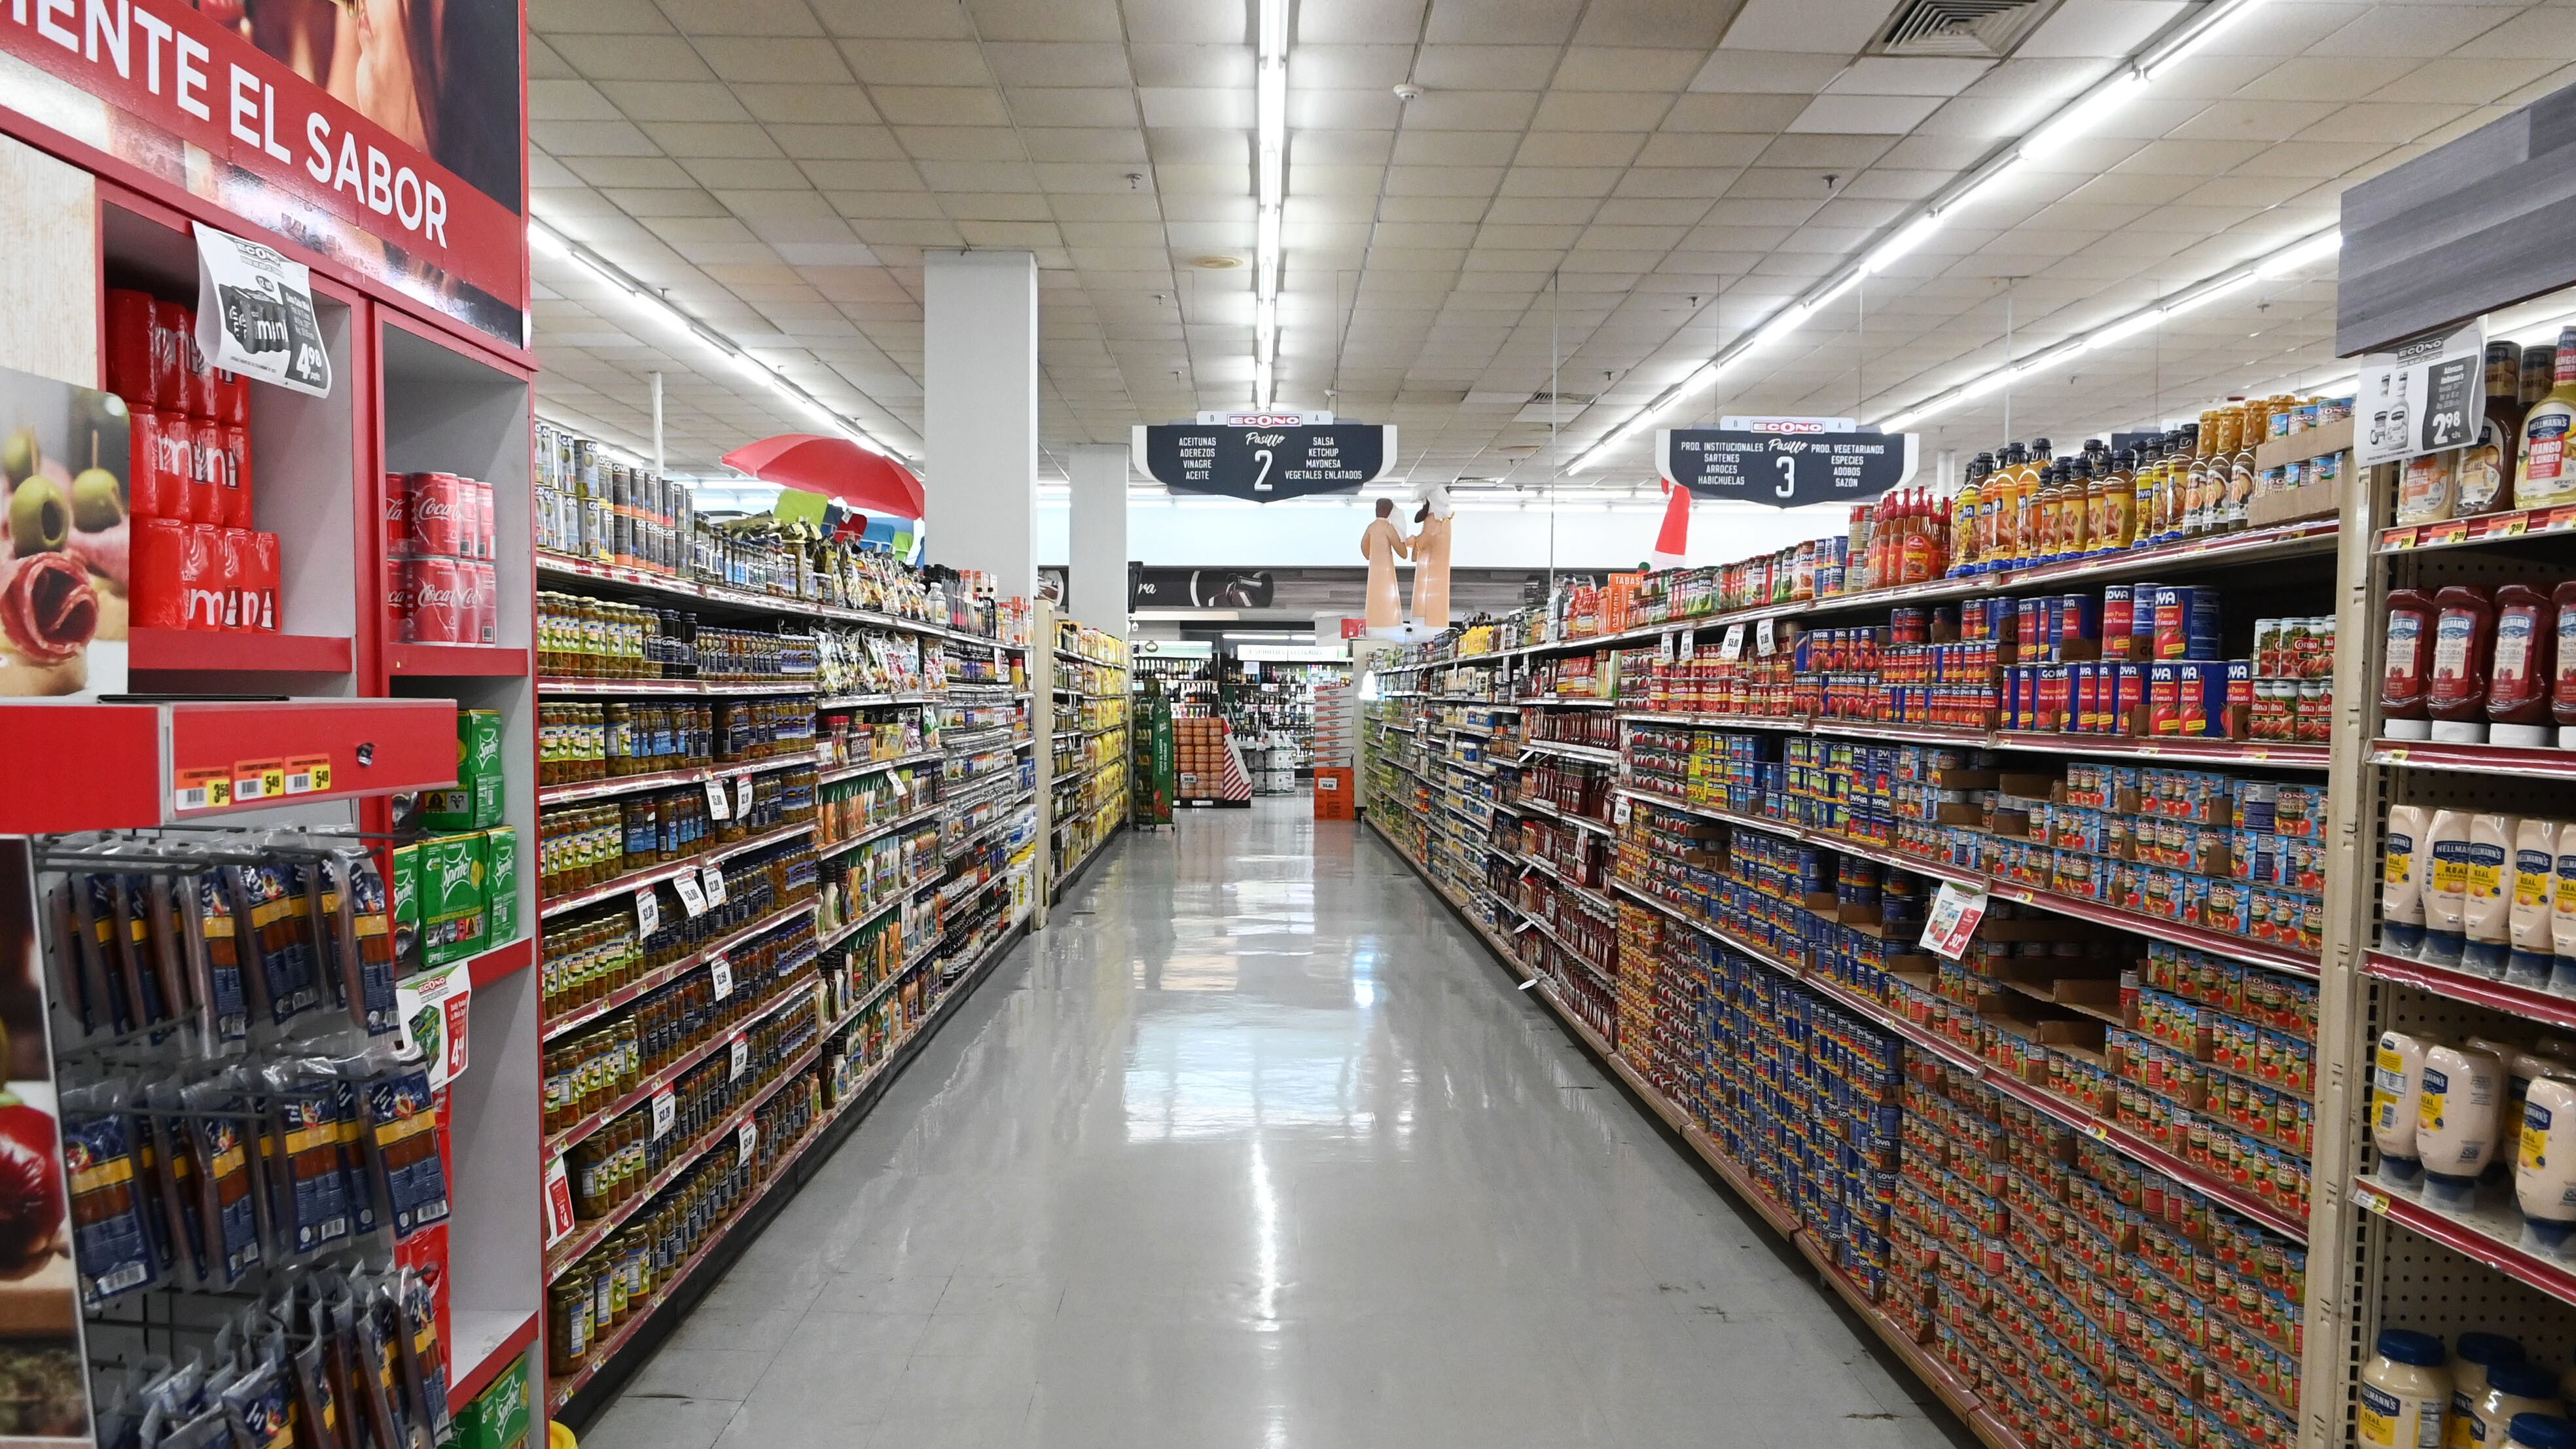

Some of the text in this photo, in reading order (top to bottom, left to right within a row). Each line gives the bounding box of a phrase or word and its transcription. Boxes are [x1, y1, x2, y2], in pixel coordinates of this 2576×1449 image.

[230, 62, 291, 165] EL
[306, 111, 447, 249] SABOR
[2398, 340, 2442, 357] ECONO
[1229, 414, 1300, 426] ECONO
[1314, 414, 1319, 422] A
[1753, 420, 1823, 433] ECONO
[2528, 417, 2567, 431] HELLMANN'S
[1179, 437, 1217, 446] ACEITUNAS
[1245, 431, 1285, 446] Pasillo
[1313, 437, 1334, 446] SALSA
[1681, 442, 1764, 452] PROD. INSTITUCIONALES
[1768, 438, 1808, 452] Pasillo
[1811, 444, 1885, 454] PROD. VEGETARIANOS
[2530, 440, 2562, 454] MANGO
[1180, 448, 1215, 457] ADEREZOS
[1308, 448, 1339, 457] KETCHUP
[1704, 453, 1740, 463] SARTENES
[1831, 455, 1864, 465] ESPECIES
[1183, 459, 1212, 469] VINAGRE
[1306, 459, 1341, 469] MAYONESA
[1254, 450, 1273, 492] 2
[1706, 465, 1738, 474] ARROCES
[1833, 467, 1861, 476] ADOBOS
[1185, 471, 1209, 480] ACEITE
[1285, 471, 1363, 480] VEGETALES ENLATADOS
[1776, 456, 1795, 499] 3
[1698, 476, 1745, 486] HABICHUELAS
[1835, 477, 1858, 487] SAZÓN
[2137, 490, 2152, 498] OYA
[1615, 576, 1644, 585] TABAS
[2155, 591, 2176, 604] OYA
[2120, 666, 2137, 675] OYA
[444, 860, 469, 887] Sprite
[2474, 869, 2489, 879] REAL
[418, 976, 446, 993] ECONO
